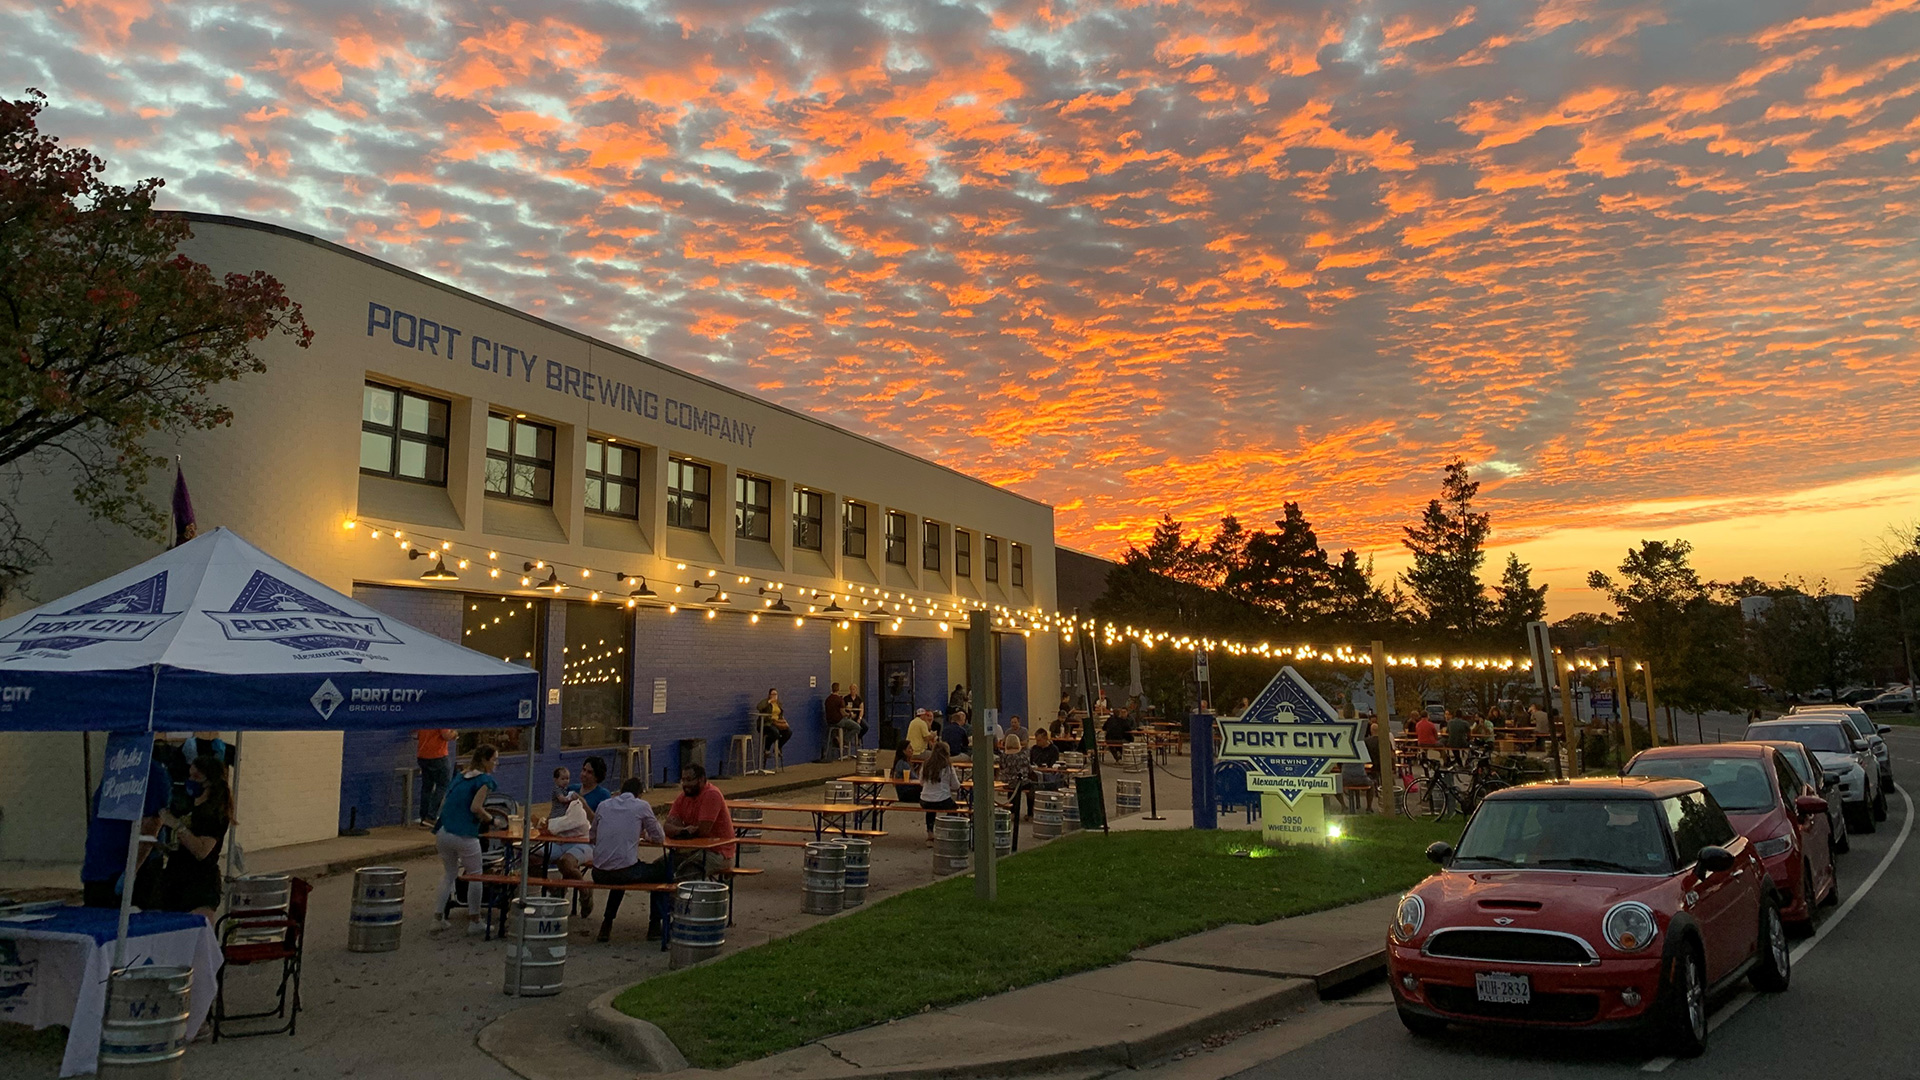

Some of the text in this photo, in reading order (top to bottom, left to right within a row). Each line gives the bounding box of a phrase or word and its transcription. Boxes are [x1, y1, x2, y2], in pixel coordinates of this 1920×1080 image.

[367, 301, 756, 449] PORT CITY BREWING COMPANY
[23, 619, 157, 635] PORT CITY
[230, 616, 377, 637] PORT CITY
[3, 686, 32, 701] CITY
[351, 688, 424, 702] PORT CITY
[349, 704, 404, 712] BREWING CO.
[1232, 731, 1342, 749] PORT CITY
[109, 747, 144, 775] Masks
[103, 774, 148, 804] Required
[1252, 777, 1329, 790] Alexandria, Virginia
[1282, 815, 1303, 825] 3950
[1268, 824, 1302, 833] WHEELER
[538, 920, 552, 934] M
[1477, 980, 1529, 997] WUH-2832
[1478, 995, 1529, 1004] PASSPORT
